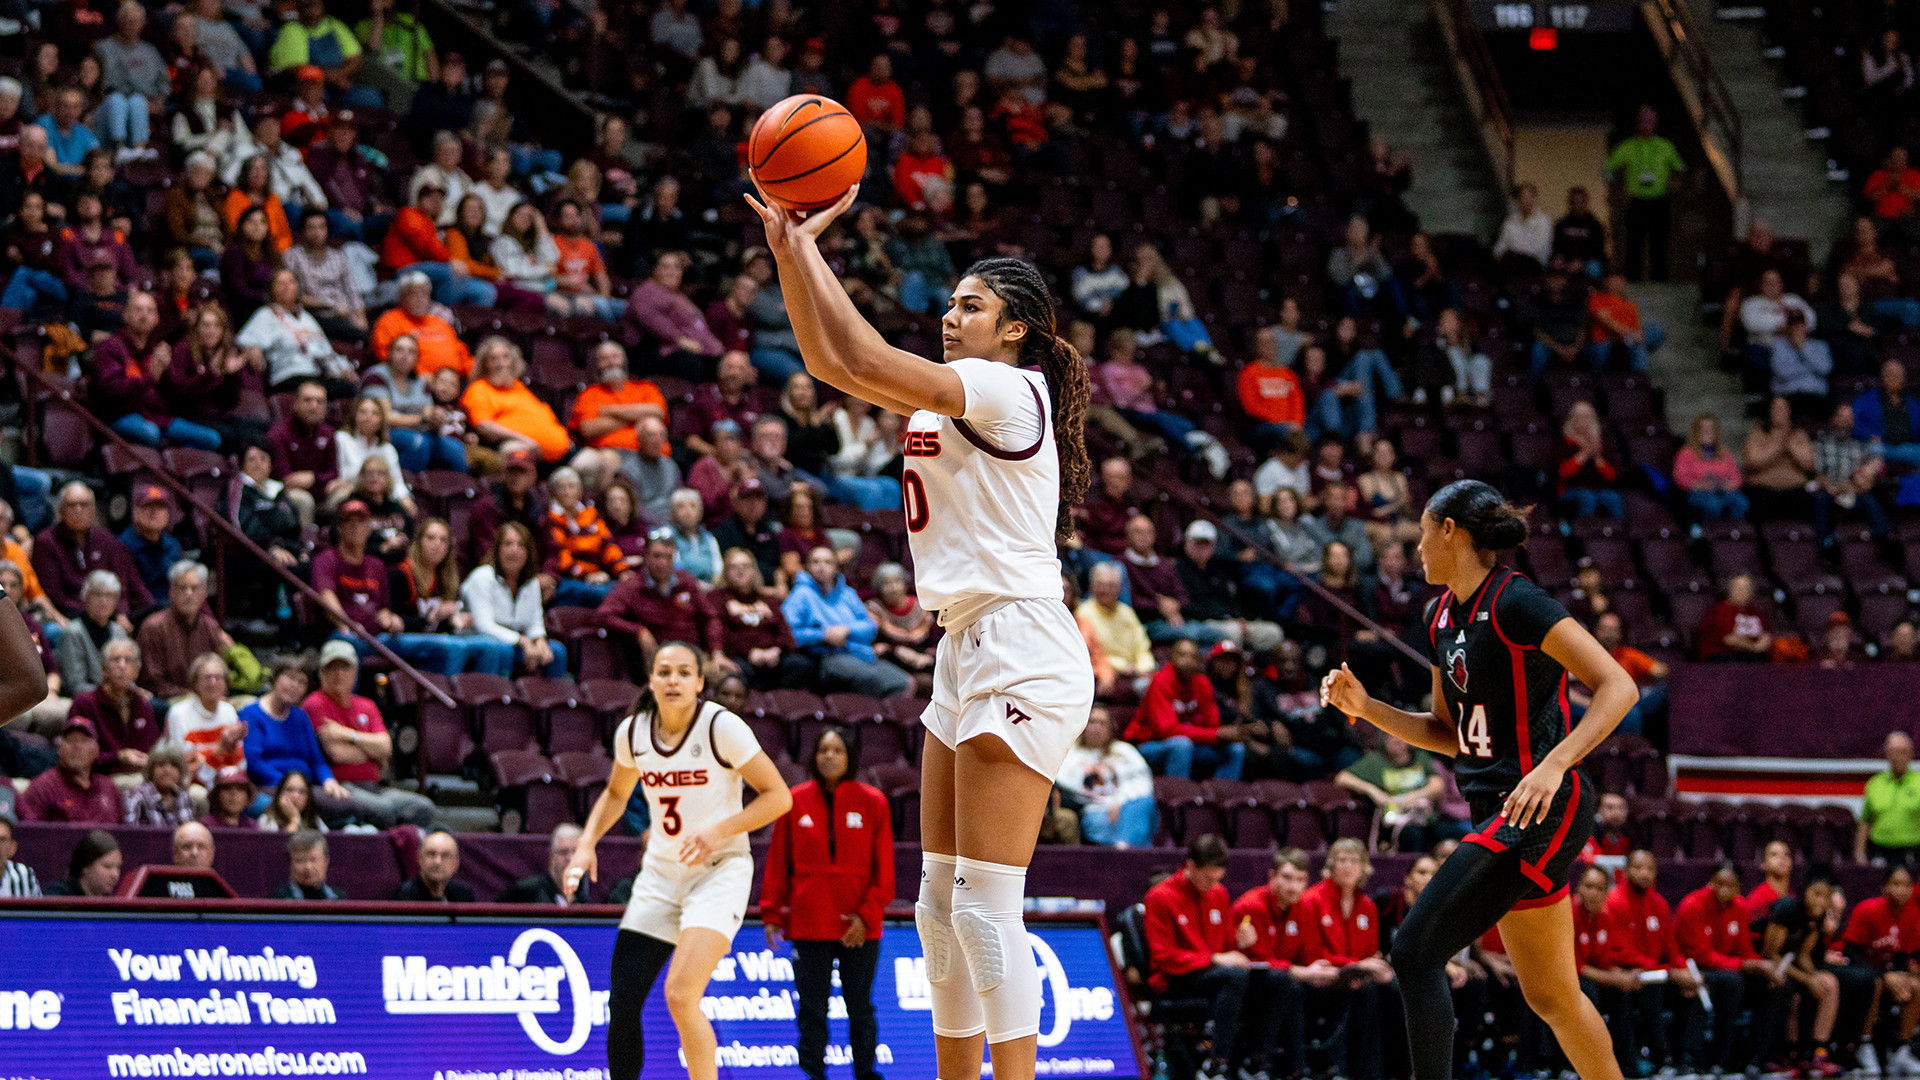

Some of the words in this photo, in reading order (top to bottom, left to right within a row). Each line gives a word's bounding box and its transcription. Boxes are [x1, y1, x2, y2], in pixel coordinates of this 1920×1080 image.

[904, 431, 941, 457] IES
[1006, 701, 1032, 725] VT
[1457, 701, 1493, 757] 14
[640, 769, 709, 787] HOKIES
[659, 796, 682, 836] 3
[108, 948, 182, 981] Your
[184, 946, 318, 989] Winning
[382, 955, 565, 1001] Member
[0, 990, 62, 1029] ne
[112, 988, 251, 1025] Financial
[250, 992, 337, 1024] Team
[107, 1046, 367, 1077] memberonefcu.com
